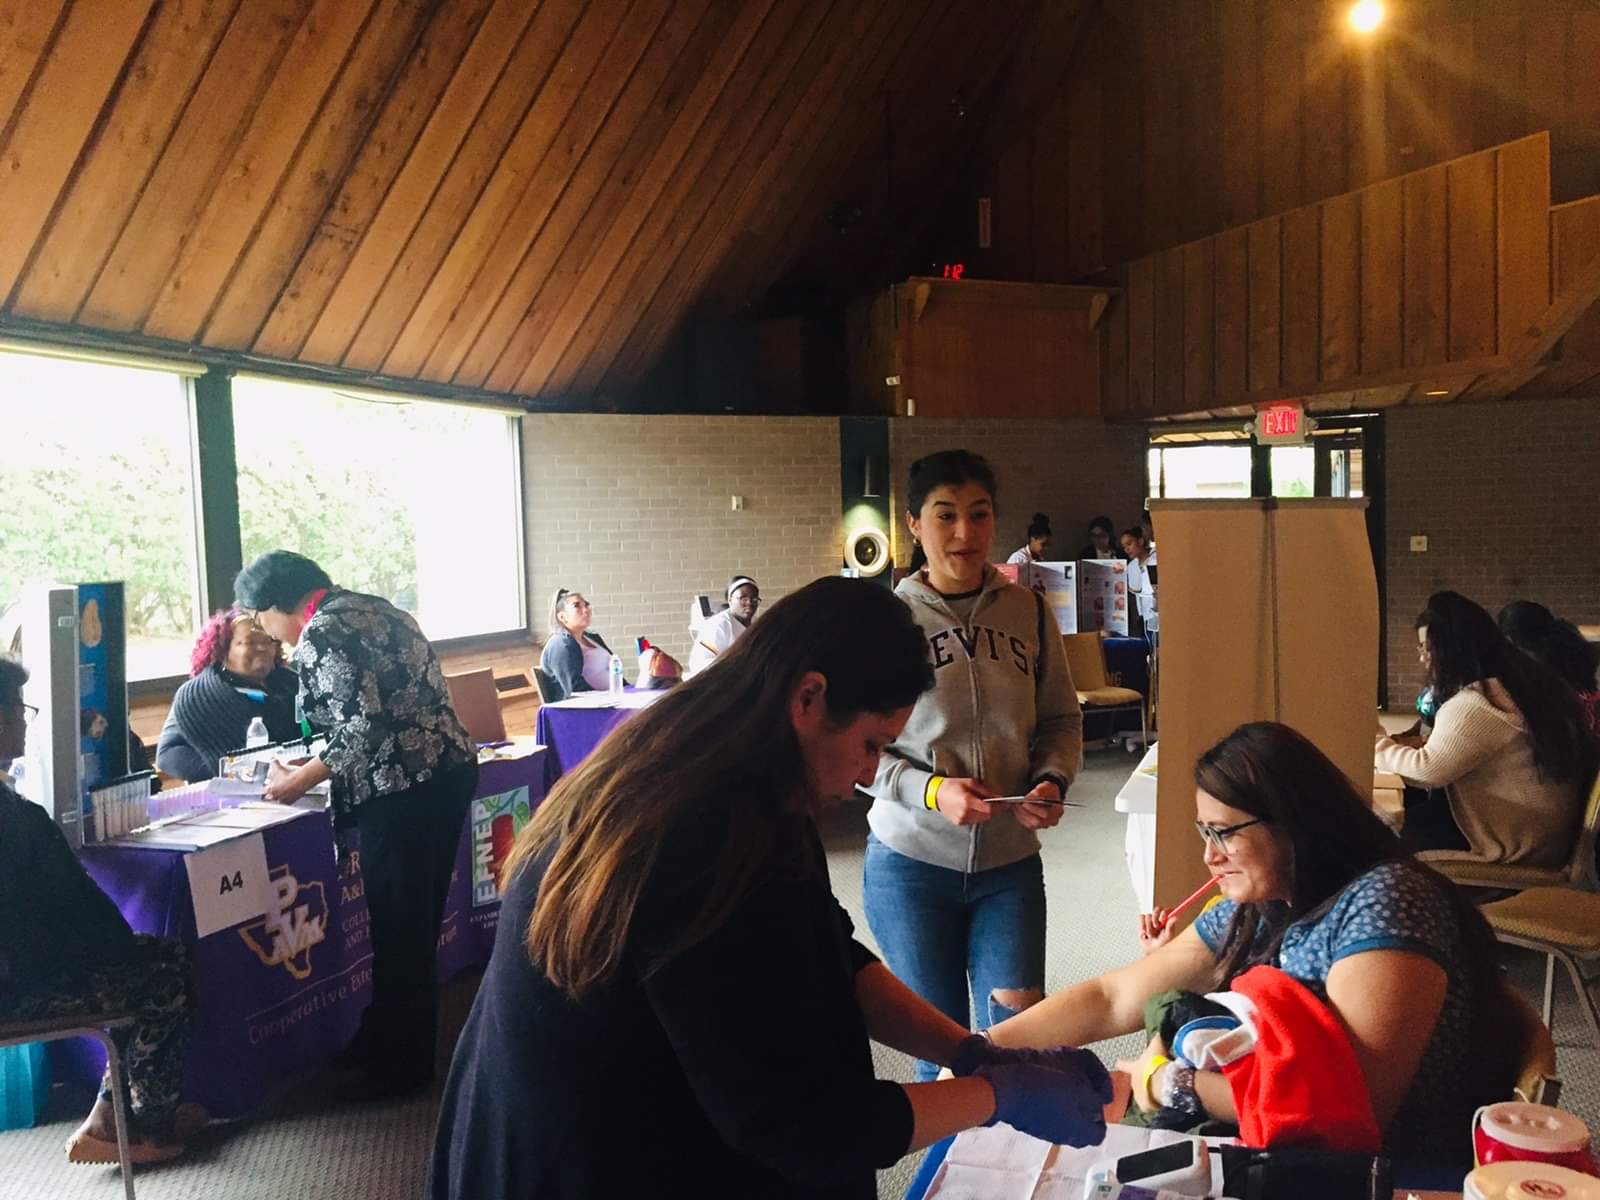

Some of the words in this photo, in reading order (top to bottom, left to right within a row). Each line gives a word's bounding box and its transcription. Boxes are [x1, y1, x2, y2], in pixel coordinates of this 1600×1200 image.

[1265, 412, 1297, 433] EXIT
[929, 625, 1030, 676] EVI'S
[476, 802, 497, 903] EFNEP
[219, 870, 244, 896] A4
[248, 985, 348, 1045] Cooperative
[351, 967, 373, 993] Exte
